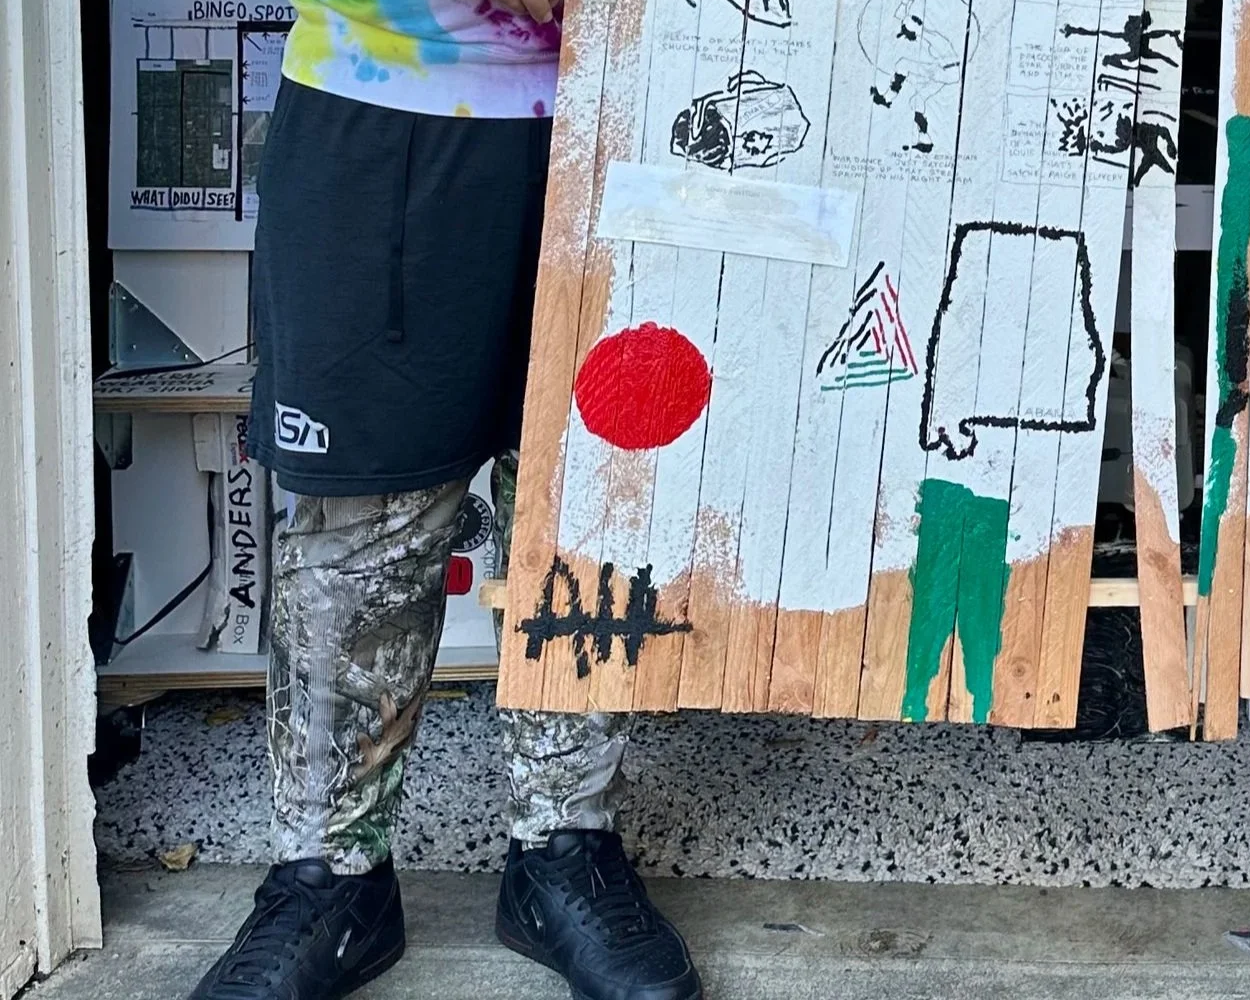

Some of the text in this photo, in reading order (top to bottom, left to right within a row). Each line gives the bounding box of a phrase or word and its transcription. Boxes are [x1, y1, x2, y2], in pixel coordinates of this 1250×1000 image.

[193, 0, 295, 21] BINGO SPOT
[130, 191, 236, 208] WHAT SEE?
[143, 386, 209, 394] SHOW
[227, 467, 258, 609] ANDERS
[233, 616, 250, 644] Box
